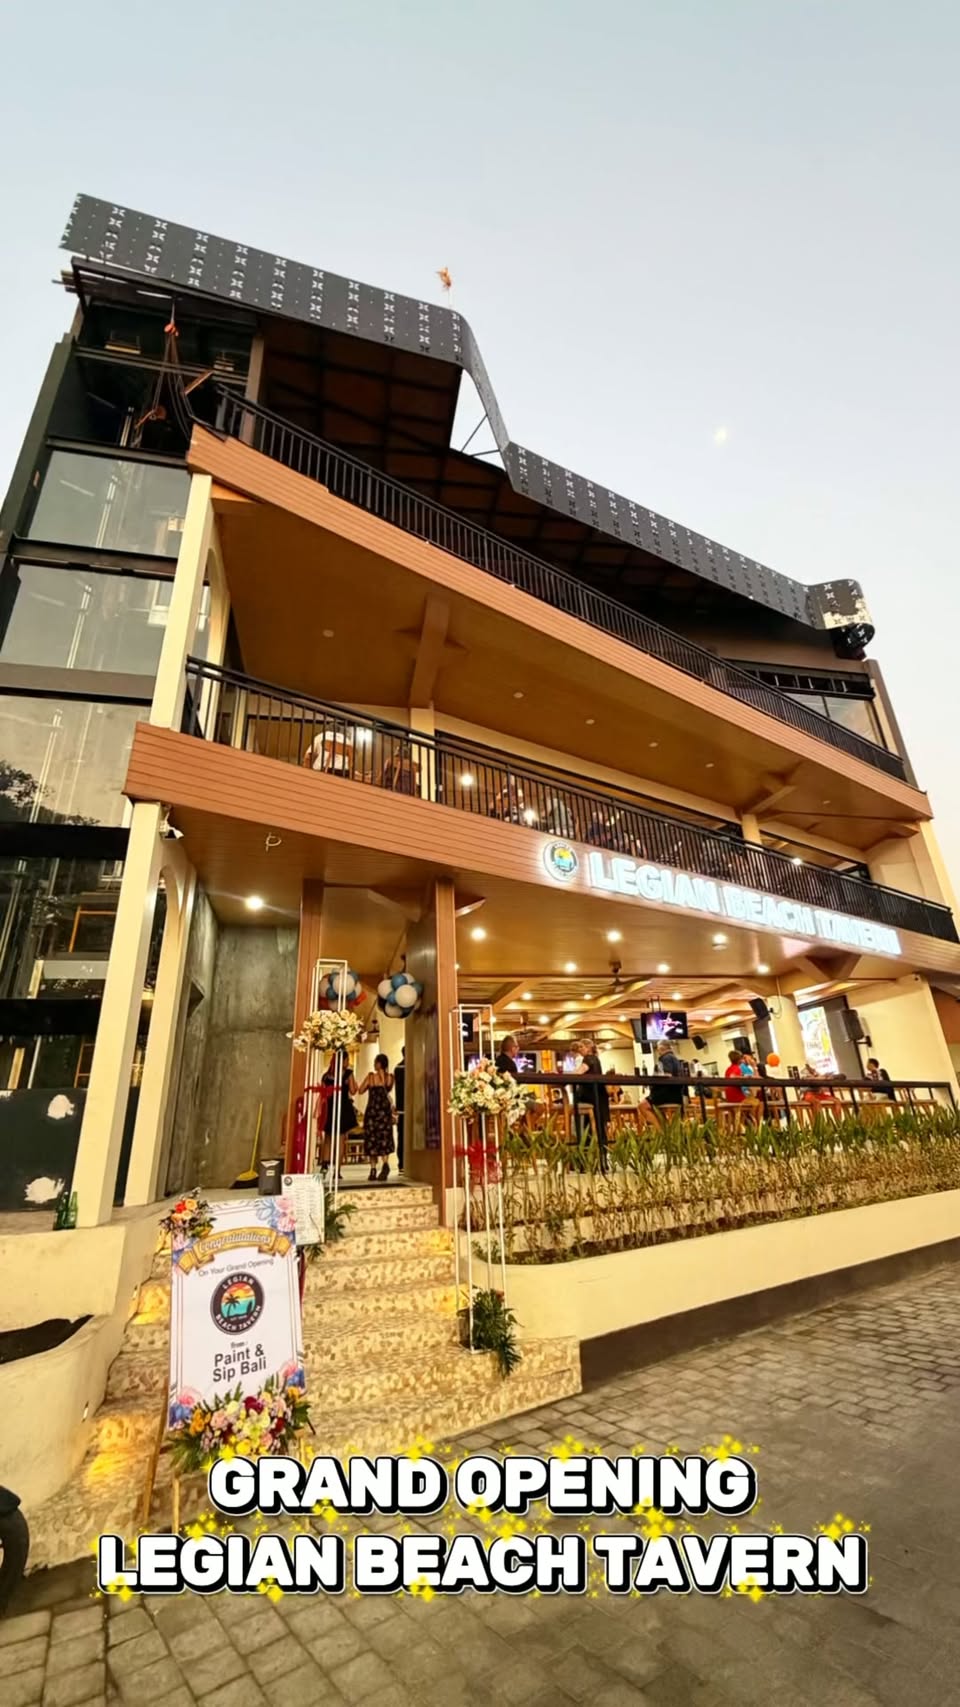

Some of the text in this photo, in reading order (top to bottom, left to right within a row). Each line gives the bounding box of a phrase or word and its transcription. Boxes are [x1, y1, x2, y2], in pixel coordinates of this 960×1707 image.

[589, 851, 721, 914] LEGIAN
[722, 885, 816, 936] BEACH
[226, 1264, 247, 1272] Grand
[247, 1259, 274, 1268] Opening
[222, 1275, 254, 1289] LEGIAN
[215, 1305, 261, 1331] BEACH TAVERN
[214, 1343, 265, 1368] Paint &
[212, 1356, 267, 1383] Sip Bali
